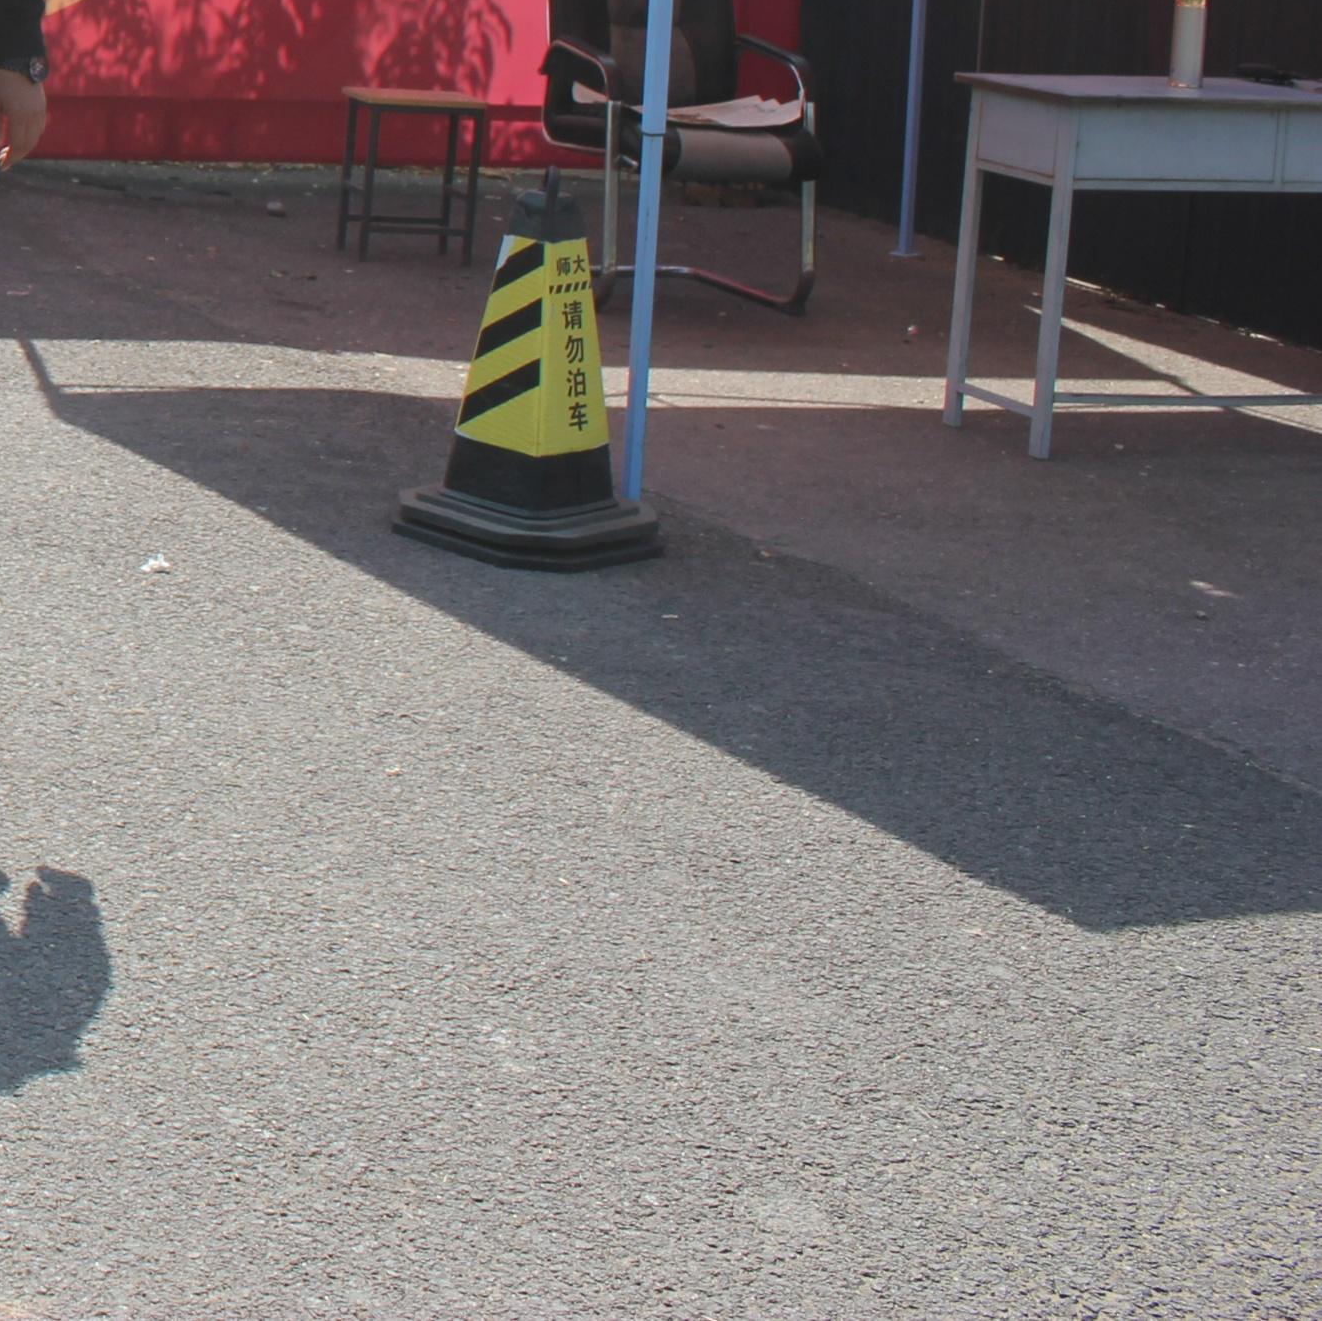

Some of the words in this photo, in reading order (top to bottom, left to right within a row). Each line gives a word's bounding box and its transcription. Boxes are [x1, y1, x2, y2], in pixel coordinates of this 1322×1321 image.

[555, 254, 586, 276] 师大
[561, 300, 589, 432] 请勿泊车
